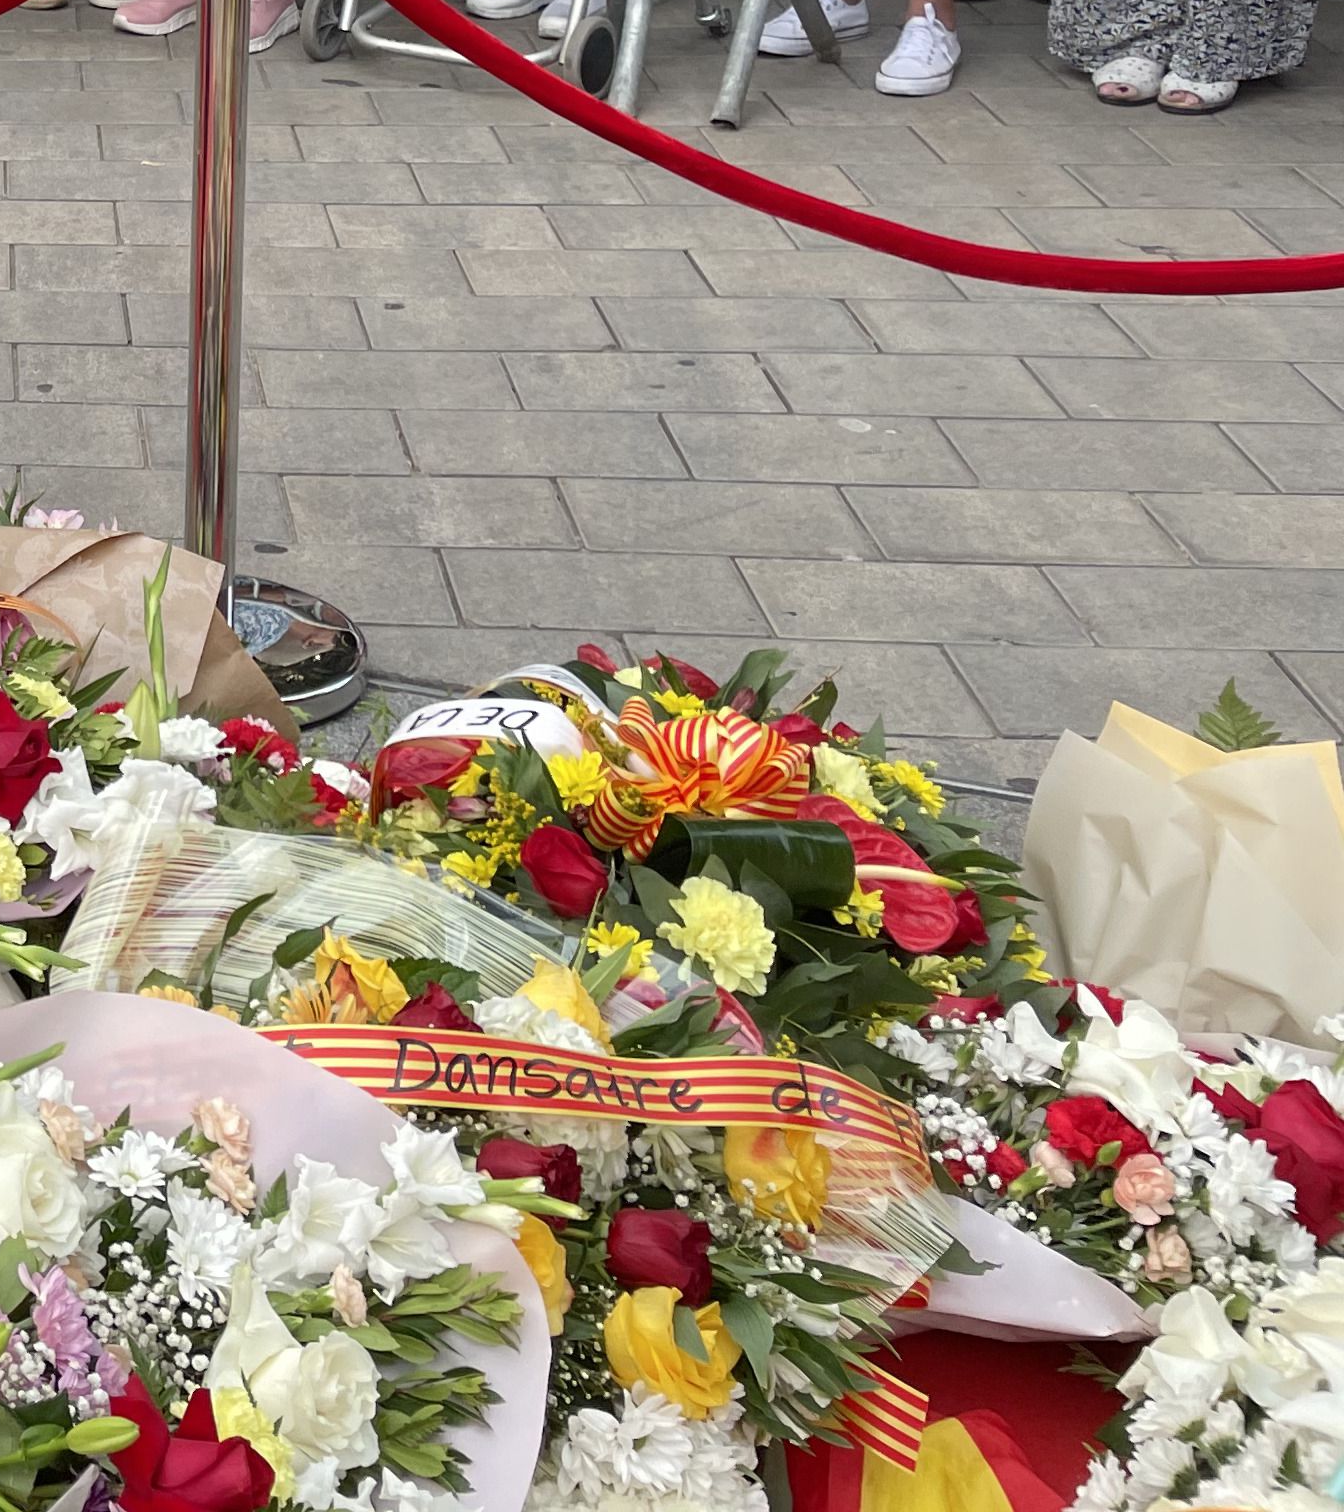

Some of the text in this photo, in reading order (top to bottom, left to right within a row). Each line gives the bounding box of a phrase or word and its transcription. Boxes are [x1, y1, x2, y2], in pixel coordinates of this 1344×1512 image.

[406, 705, 540, 733] DE LA
[385, 1037, 705, 1113] Dansaire
[770, 1062, 851, 1124] de
